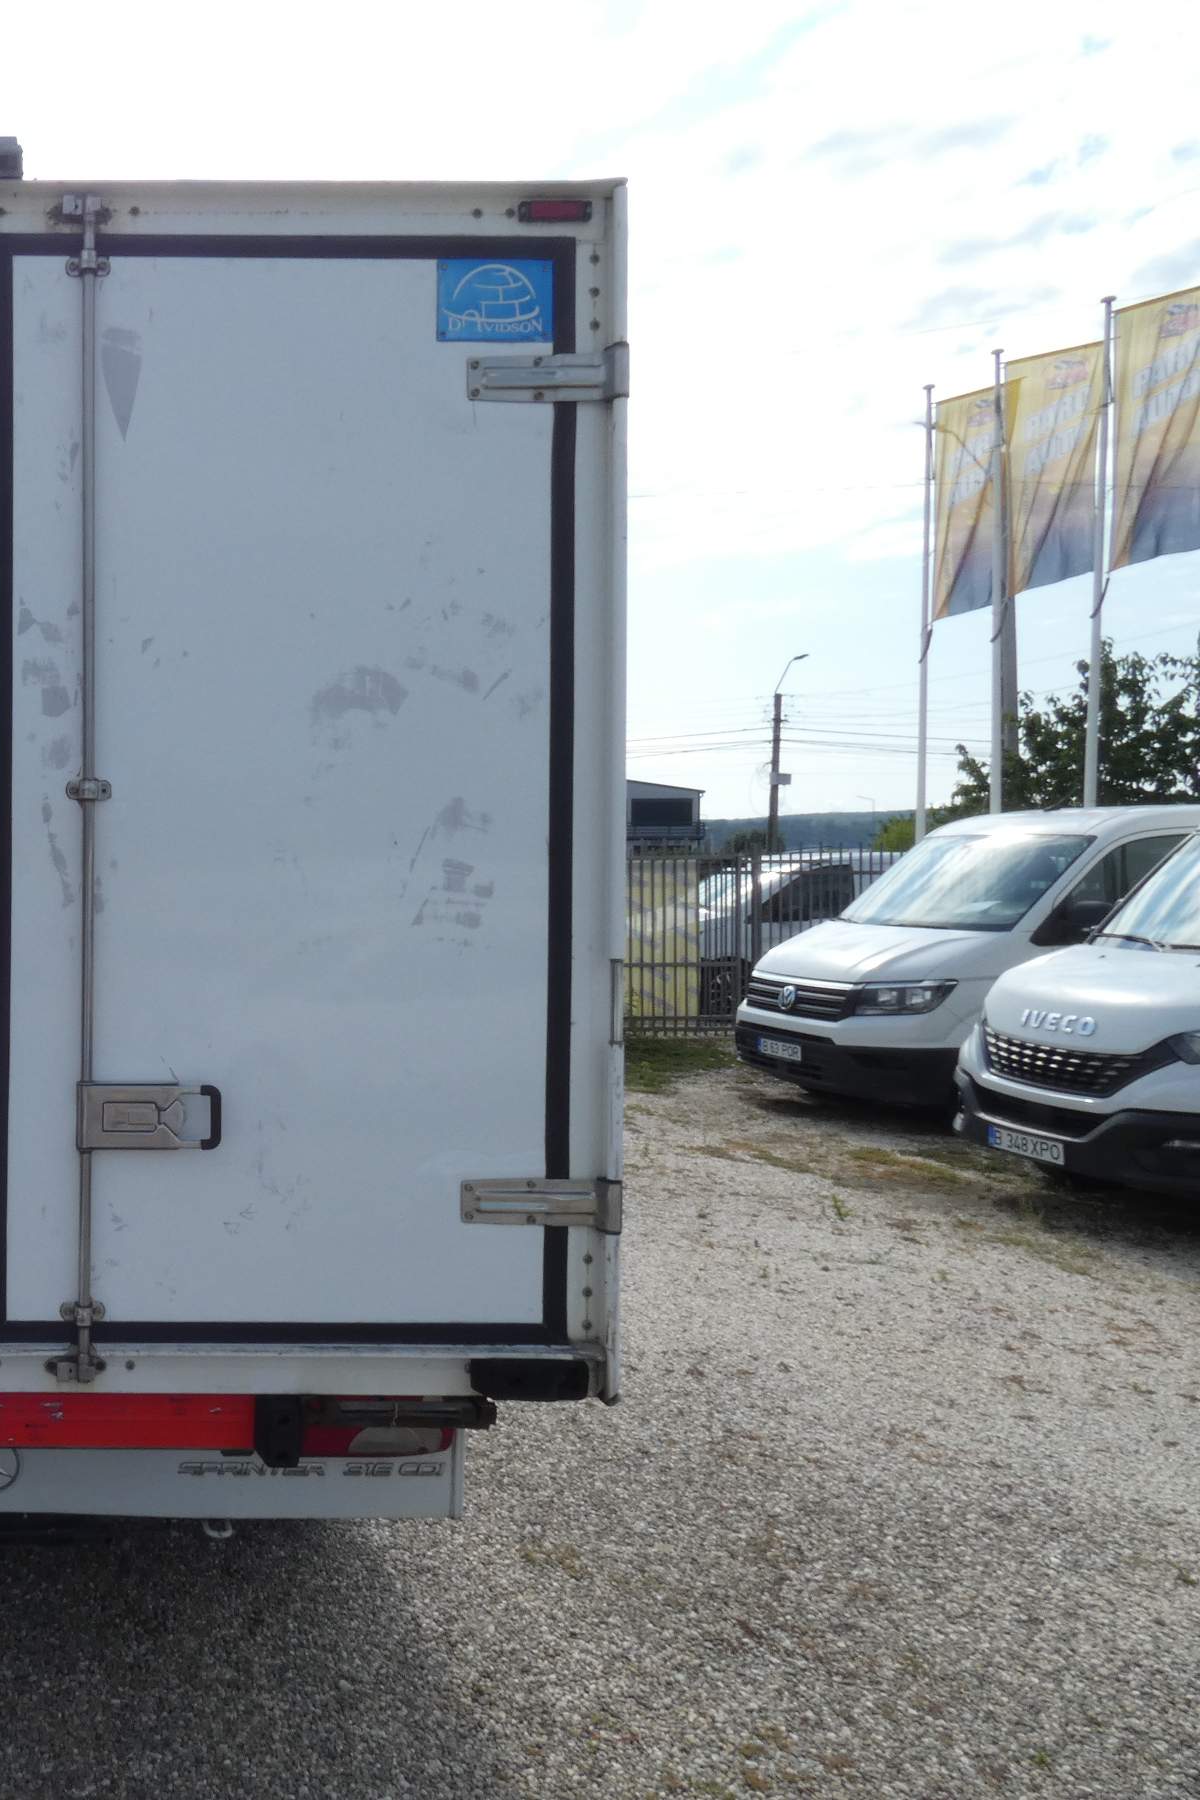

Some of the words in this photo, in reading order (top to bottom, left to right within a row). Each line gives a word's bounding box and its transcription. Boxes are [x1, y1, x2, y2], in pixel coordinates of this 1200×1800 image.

[1020, 1008, 1097, 1037] IVECO
[763, 1039, 769, 1052] B
[1007, 1133, 1029, 1152] 348
[1030, 1138, 1061, 1161] XPO
[398, 1461, 447, 1477] CDI
